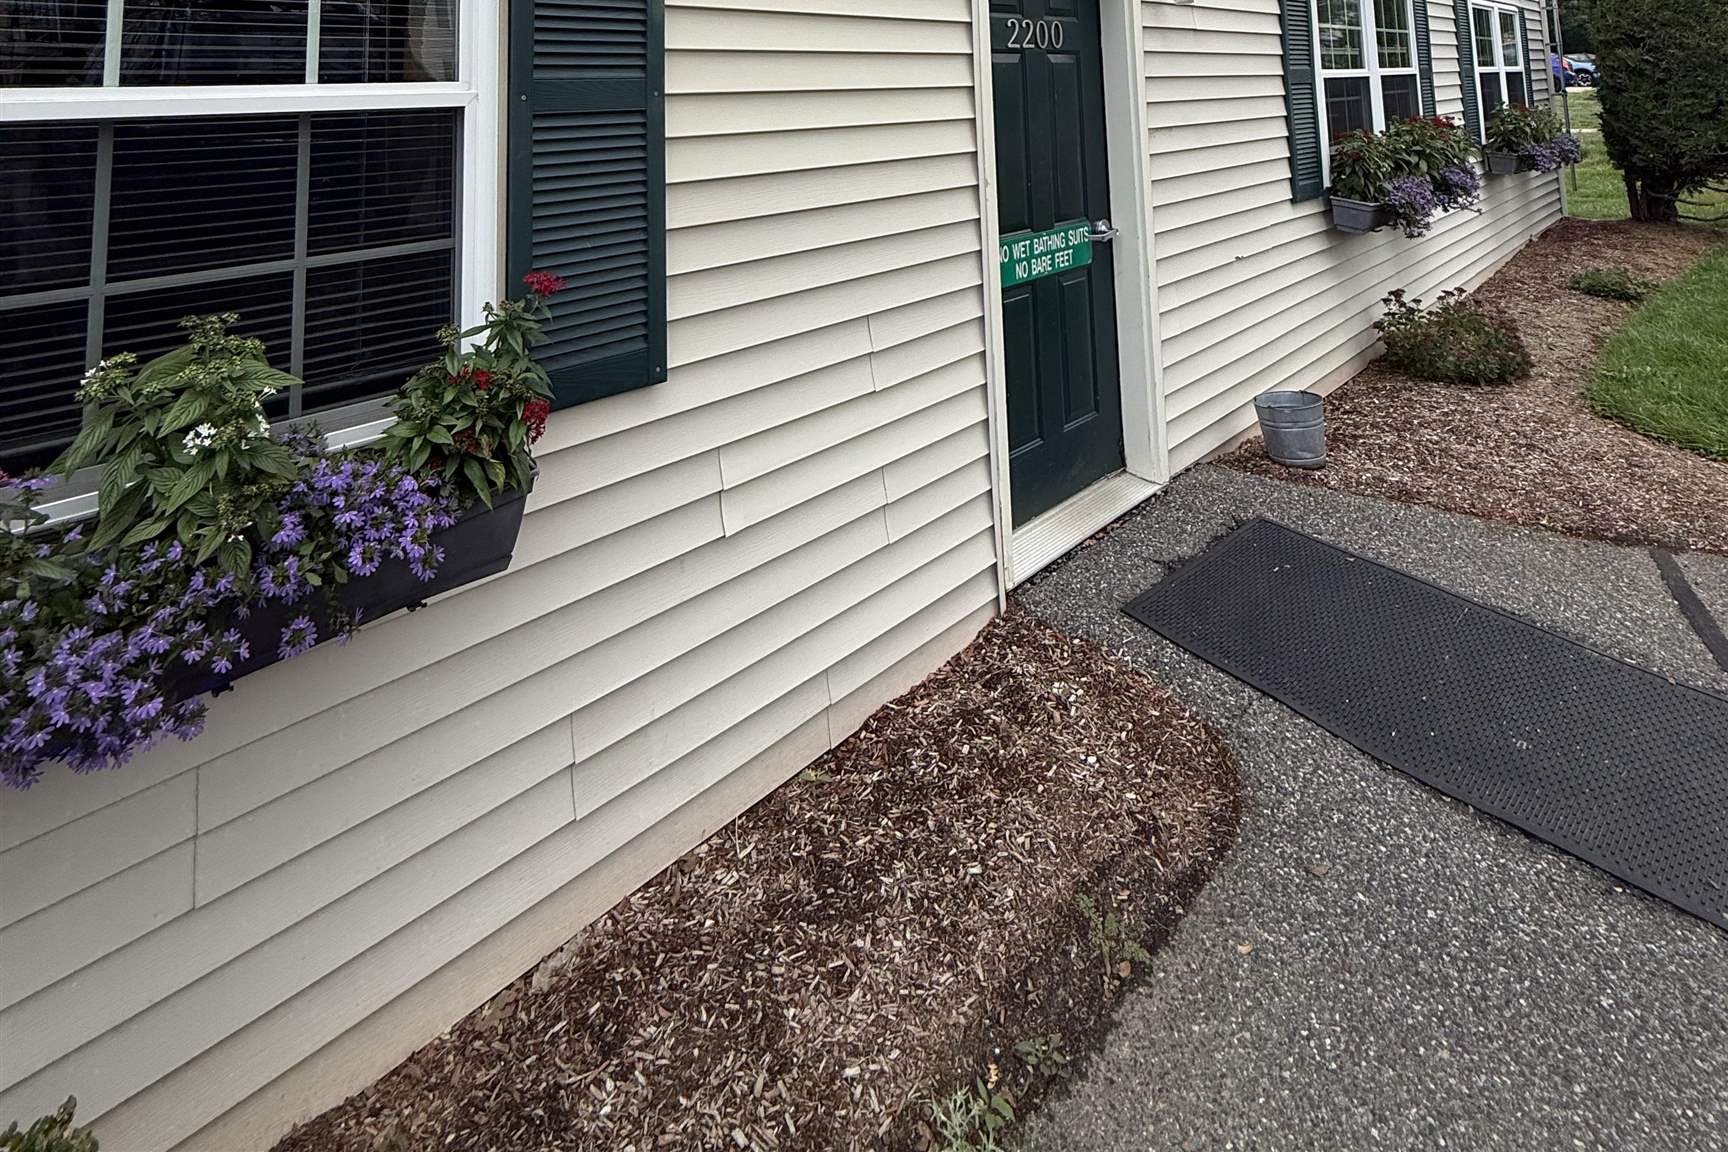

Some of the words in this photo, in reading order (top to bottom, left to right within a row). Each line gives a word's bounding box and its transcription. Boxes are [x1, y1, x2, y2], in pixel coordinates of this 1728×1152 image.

[1007, 18, 1063, 49] 2200
[1012, 240, 1031, 260] WET
[1033, 232, 1065, 255] BATHING
[1068, 226, 1089, 246] SUITS
[1015, 261, 1028, 280] NO
[1031, 254, 1052, 275] BARE
[1054, 249, 1073, 269] FEET
